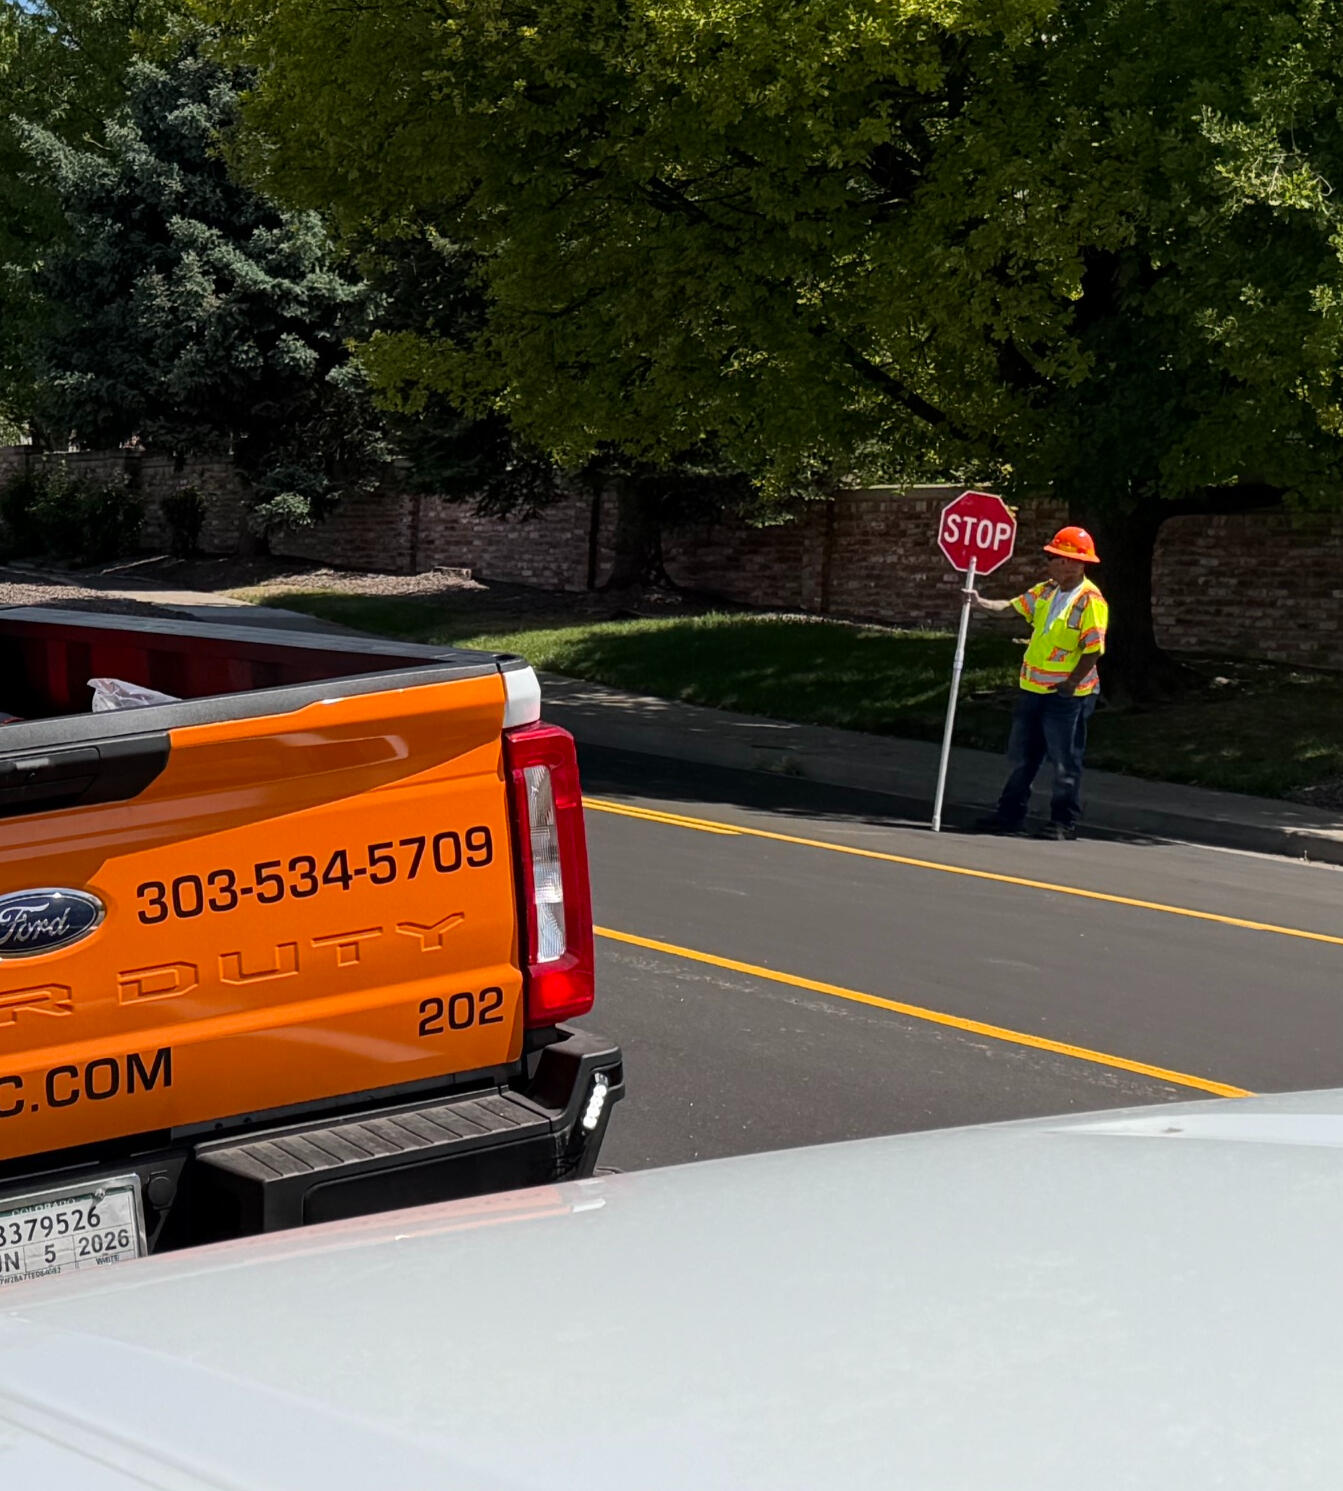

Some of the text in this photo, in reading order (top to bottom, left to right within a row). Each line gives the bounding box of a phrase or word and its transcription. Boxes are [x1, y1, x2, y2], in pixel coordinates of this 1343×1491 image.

[943, 514, 1012, 551] STOP
[136, 825, 494, 925] 303-534-5709
[117, 912, 465, 1005] DUTY
[418, 986, 504, 1036] 202
[44, 1244, 56, 1263] 5
[78, 1228, 130, 1256] 2026
